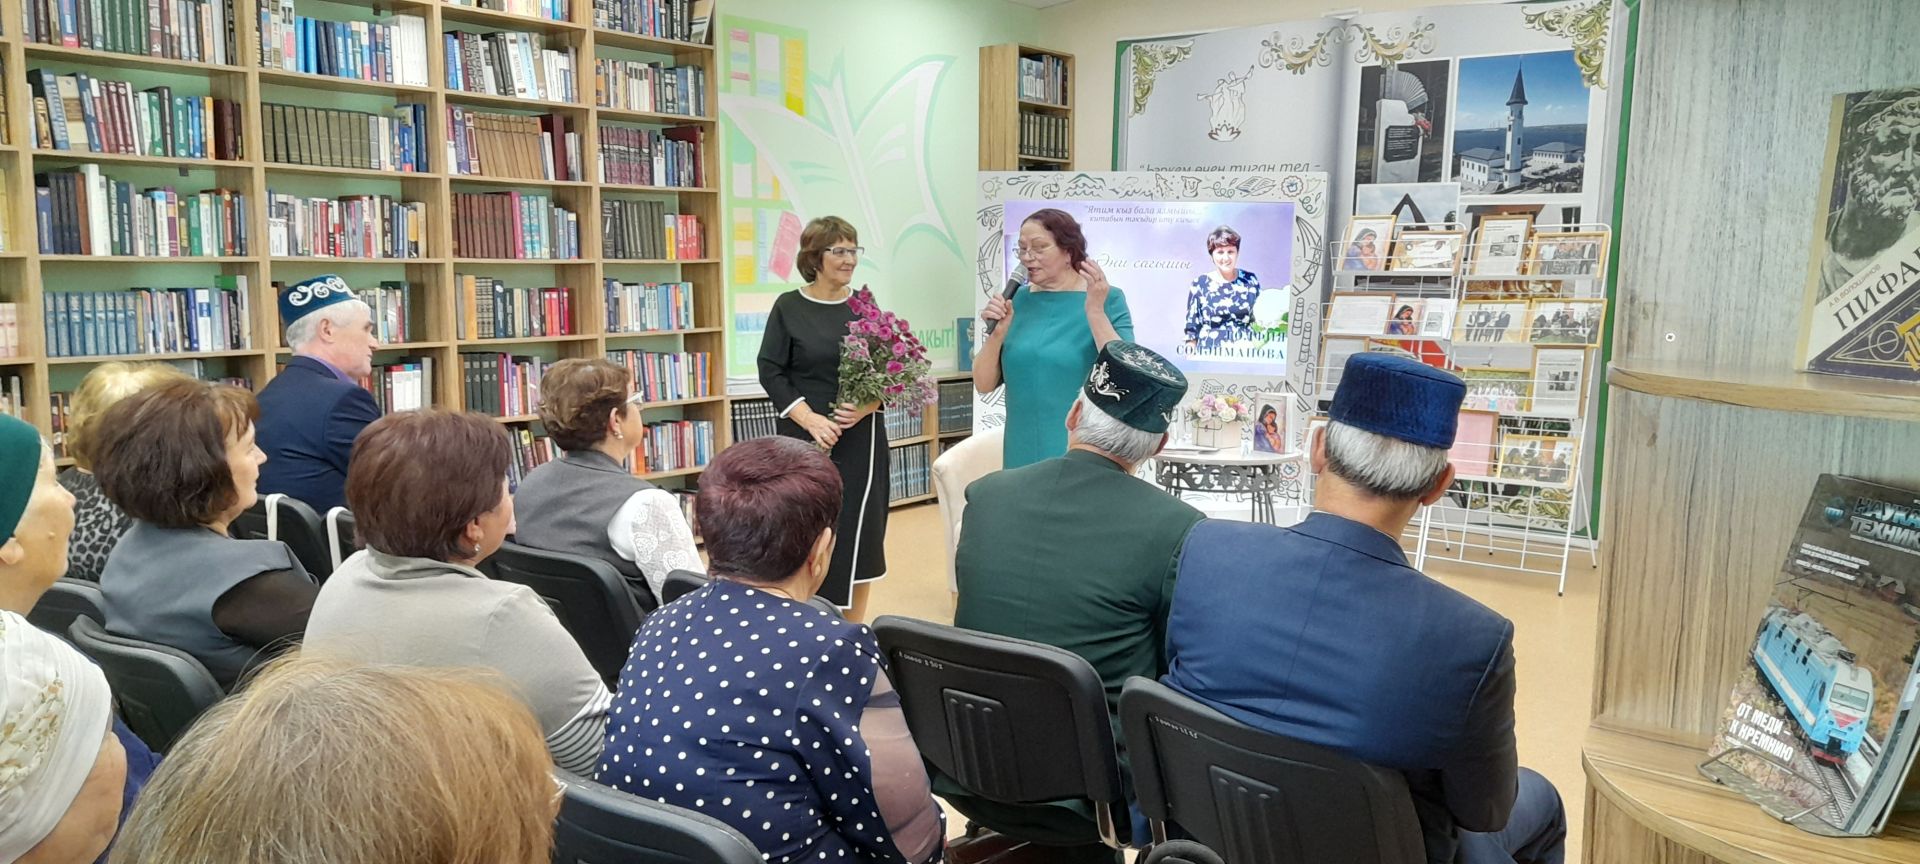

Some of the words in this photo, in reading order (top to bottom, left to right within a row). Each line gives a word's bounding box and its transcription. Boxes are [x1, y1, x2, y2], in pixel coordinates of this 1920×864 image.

[913, 320, 955, 349] АКЫТ!
[1736, 702, 1753, 720] ОТ
[1750, 709, 1784, 735] МЕДИ
[1729, 718, 1741, 734] К
[1738, 723, 1794, 762] КРЕМНИЮ
